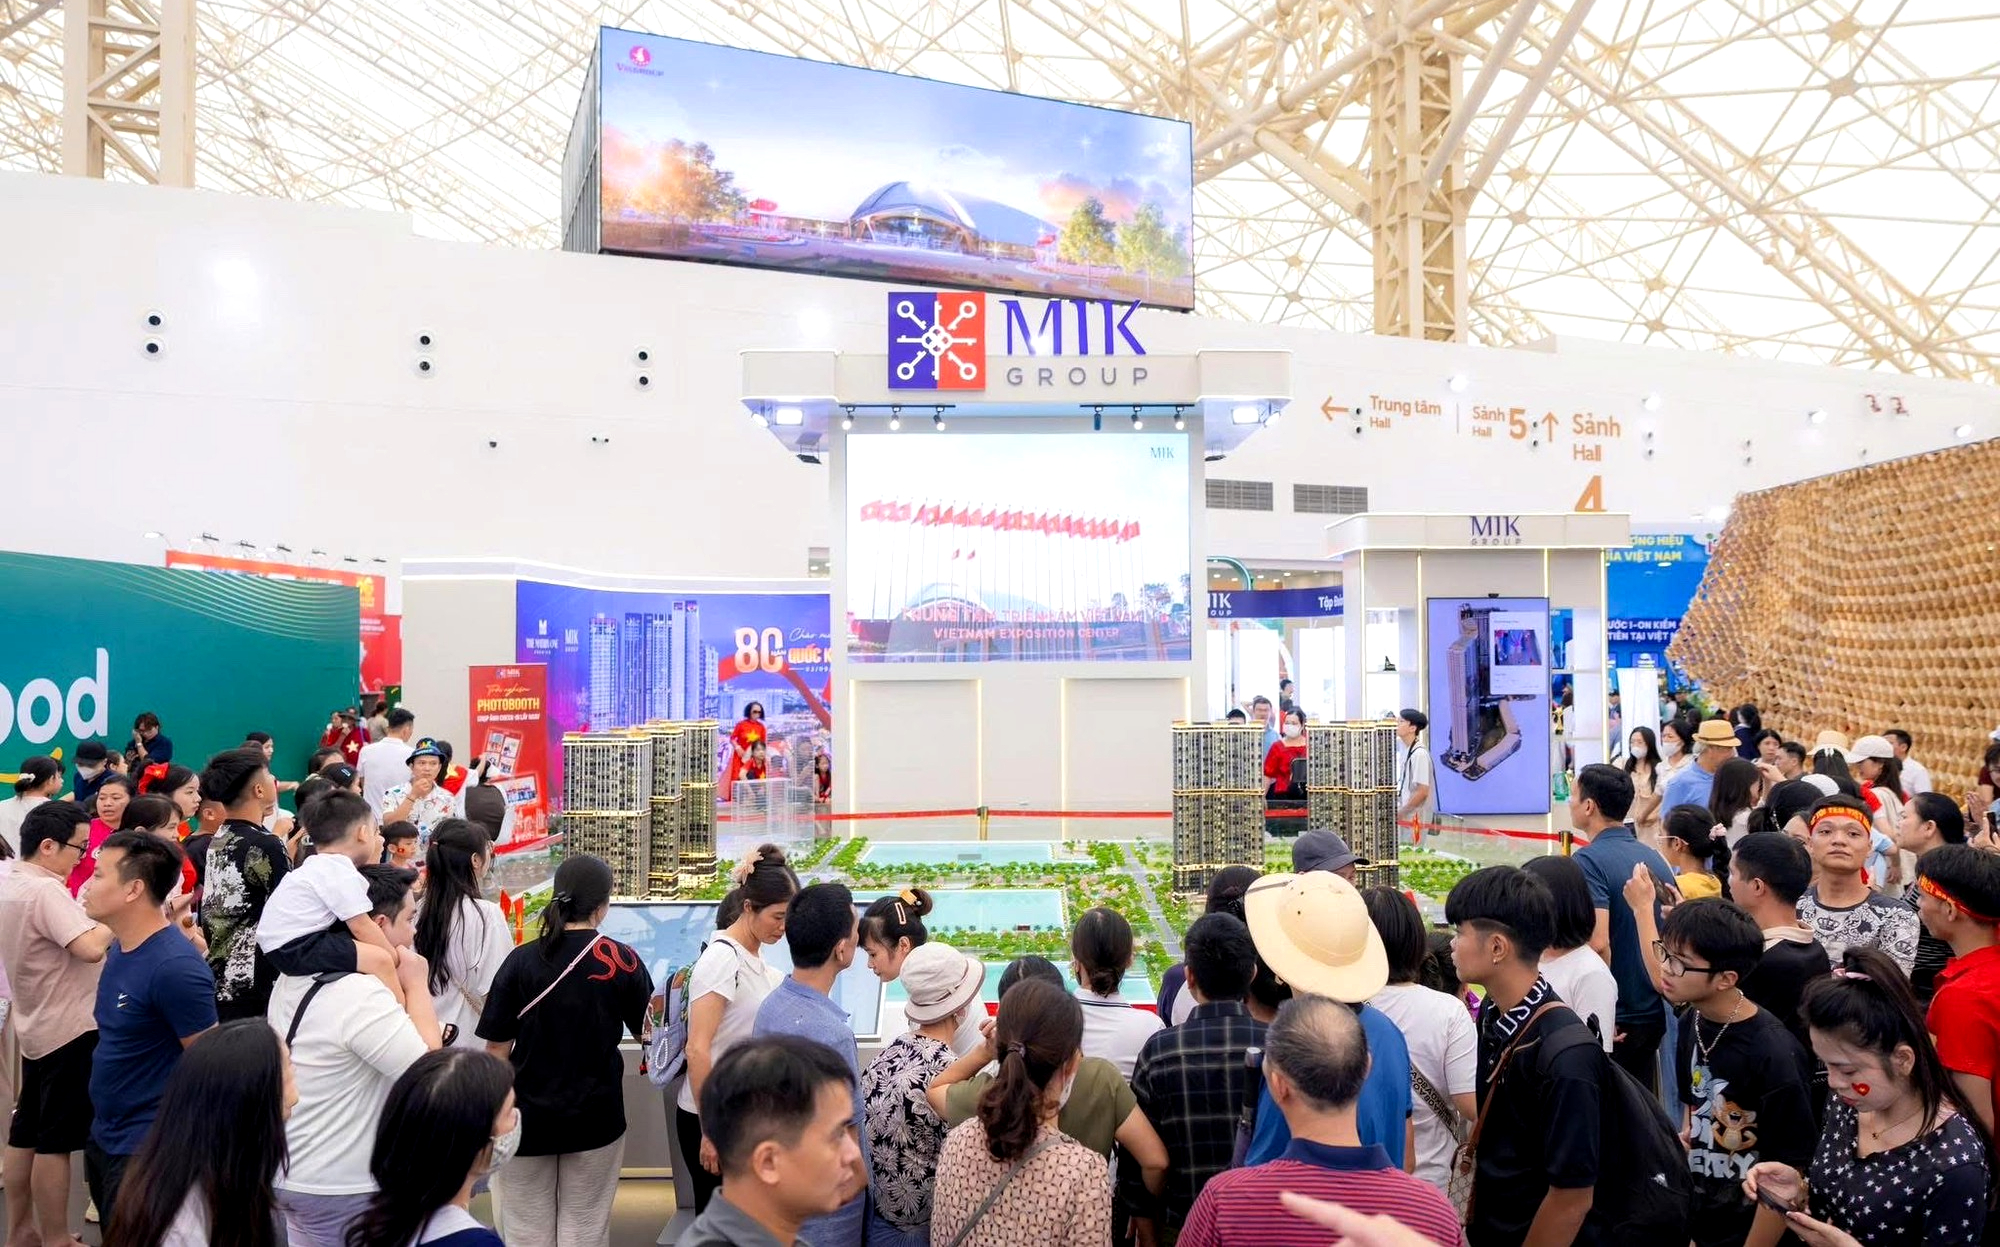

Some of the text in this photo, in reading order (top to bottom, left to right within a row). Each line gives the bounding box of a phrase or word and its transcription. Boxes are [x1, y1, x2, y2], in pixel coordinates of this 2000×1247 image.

[999, 299, 1146, 356] MIK
[1006, 367, 1148, 386] GROUP
[1370, 395, 1442, 417] Trung tâm
[1370, 416, 1391, 429] Hall
[1472, 425, 1492, 437] Hall
[1473, 406, 1528, 440] Sảnh 5
[1572, 412, 1621, 438] Sảnh
[1150, 446, 1174, 459] MIK
[1573, 443, 1602, 462] Hall
[1574, 475, 1607, 512] 4
[1470, 515, 1520, 536] MIK
[1471, 538, 1522, 547] GROUP
[1655, 550, 1682, 561] NAM
[1207, 593, 1232, 609] IK
[934, 628, 996, 640] VIETNAM
[1000, 628, 1075, 639] EXPOSITION
[477, 698, 541, 712] PHOTOBOOTH
